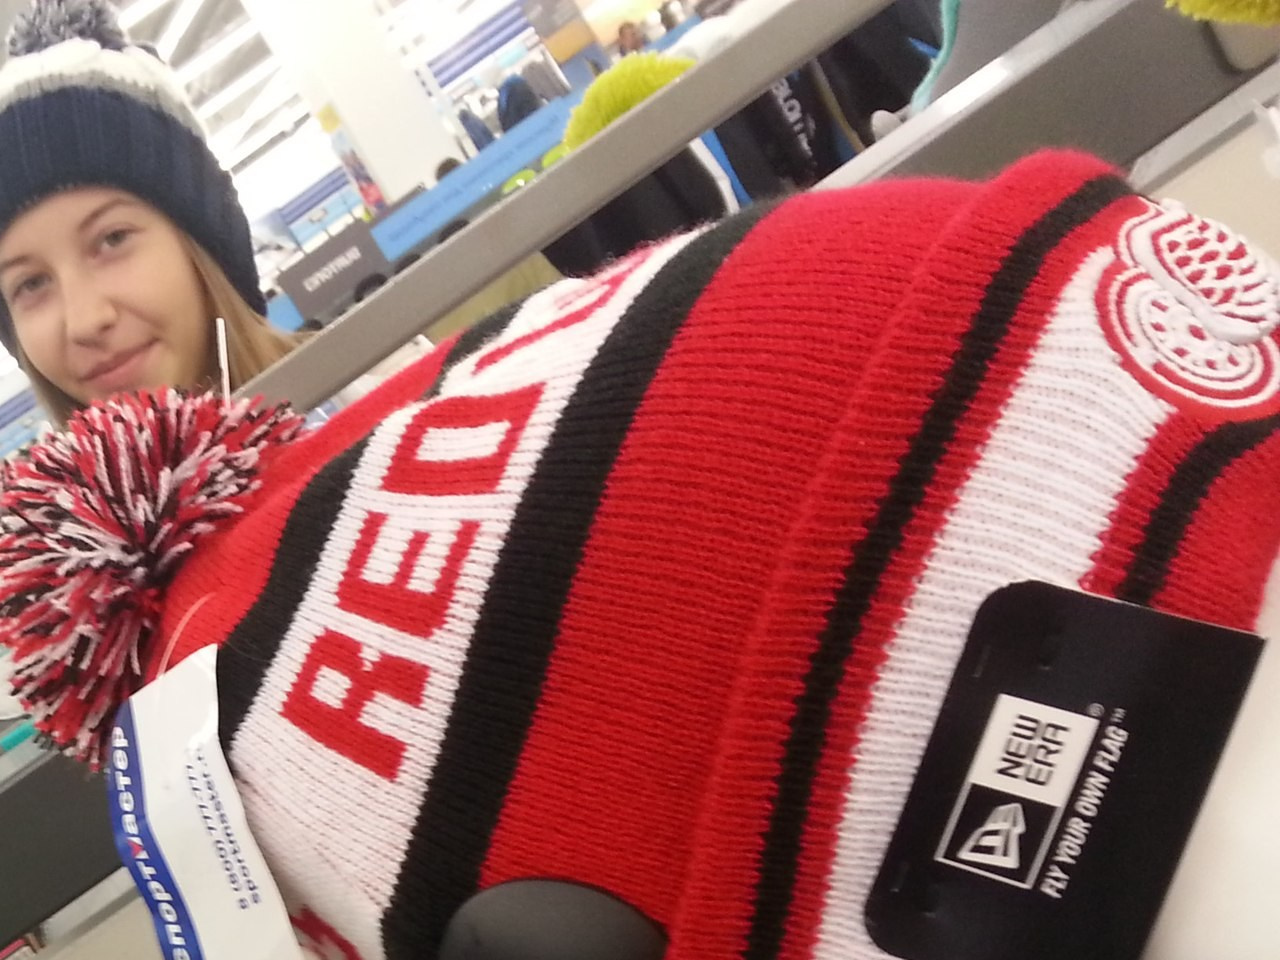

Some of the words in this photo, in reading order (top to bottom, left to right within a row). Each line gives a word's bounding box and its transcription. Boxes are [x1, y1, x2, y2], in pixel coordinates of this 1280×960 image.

[281, 382, 546, 781] RED
[996, 714, 1041, 780] NEW
[1025, 722, 1070, 786] ERA
[1074, 770, 1111, 817] OWN
[214, 839, 242, 892] (800)
[1052, 816, 1093, 865] YOUR
[238, 897, 250, 910] 8
[1039, 864, 1070, 899] FLY
